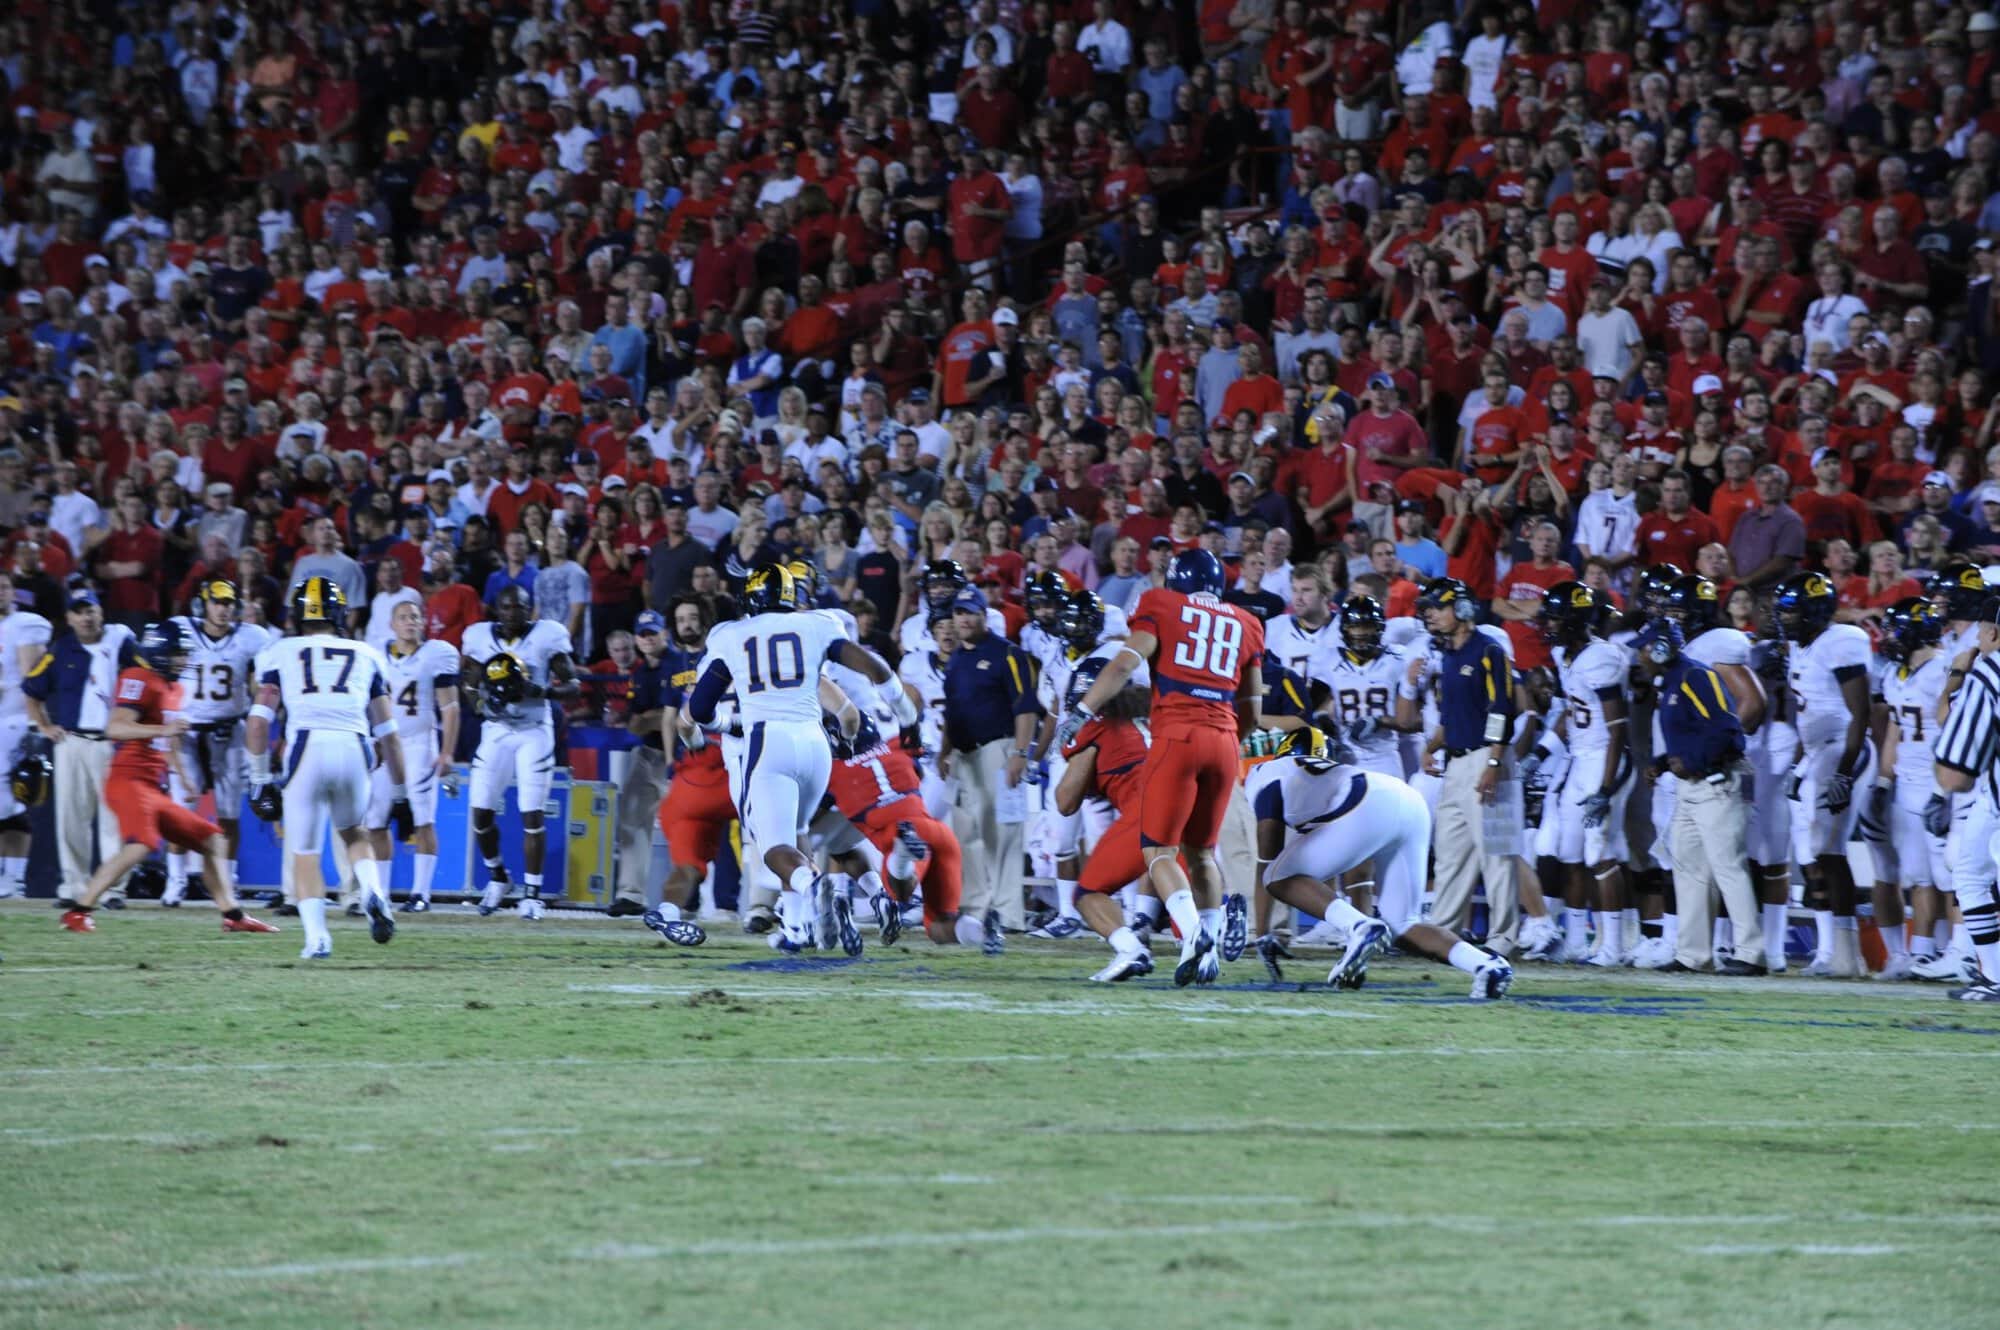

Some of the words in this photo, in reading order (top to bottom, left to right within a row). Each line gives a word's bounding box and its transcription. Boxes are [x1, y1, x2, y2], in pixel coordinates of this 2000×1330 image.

[1604, 516, 1617, 553] 7
[743, 631, 805, 694] 10
[1174, 605, 1242, 679] 38
[192, 664, 234, 701] 13
[298, 647, 356, 694] 17
[1339, 687, 1388, 727] 88
[861, 757, 908, 808] 1
